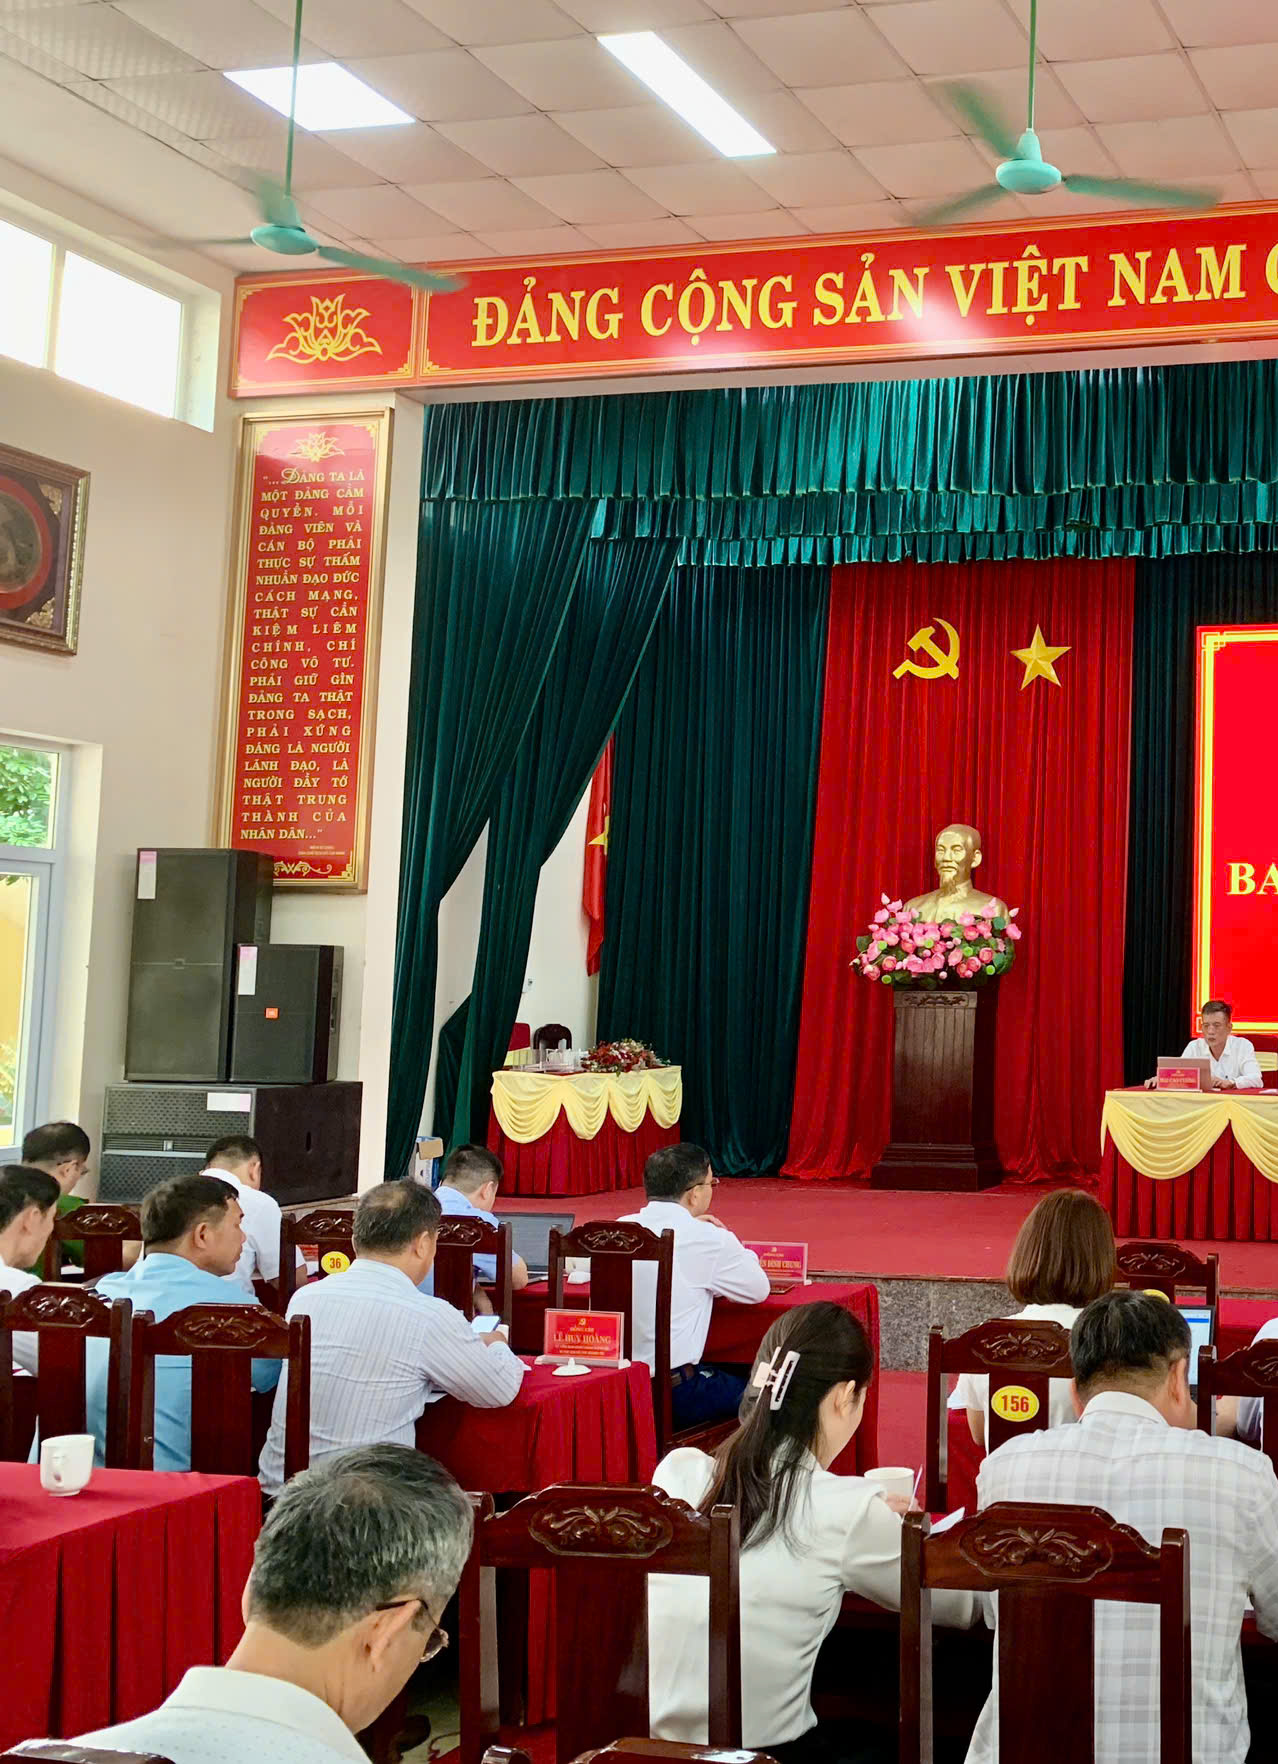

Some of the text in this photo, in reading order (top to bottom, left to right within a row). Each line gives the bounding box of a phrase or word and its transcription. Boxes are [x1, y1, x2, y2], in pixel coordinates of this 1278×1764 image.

[472, 276, 623, 347] ĐẢNG
[640, 268, 798, 346] CỘNG
[813, 252, 927, 325] SẢN
[945, 244, 1089, 326] VIỆT
[1109, 244, 1246, 306] NAM
[329, 472, 345, 481] TA
[349, 469, 365, 480] LÀ
[262, 482, 364, 502] MỘT ĐẢNG CẦM
[333, 501, 363, 515] MỖI
[258, 536, 361, 552] CÁN BỘ PHẢI
[257, 552, 360, 569] THỰC SỰ THẤM
[256, 570, 359, 585] NHUẦN ĐẠO ĐỨC
[255, 590, 296, 602] CÁCH
[253, 622, 356, 637] KIỆM LIÊM
[327, 638, 355, 650] CHÍ
[251, 657, 288, 669] CÔNG
[302, 656, 318, 668] VÔ
[250, 672, 354, 686] PHẢI GIỮ GÌN
[248, 690, 353, 704] ĐẢNG TA THẬT
[248, 710, 294, 720] TRONG
[247, 724, 351, 736] PHẢI XỨNG
[246, 741, 350, 754] ĐÁNG LÀ NGƯỜI
[245, 759, 278, 770] LÃNH
[333, 758, 349, 770] LÀ
[244, 772, 348, 788] NGƯỜI ĐẦY TỚ
[242, 808, 346, 822] THÀNH CỦA
[241, 830, 275, 839] NHÂN
[330, 1258, 341, 1268] 36
[554, 1331, 611, 1344] LÊ HUY HOÀNG
[1001, 1395, 1029, 1412] 156
